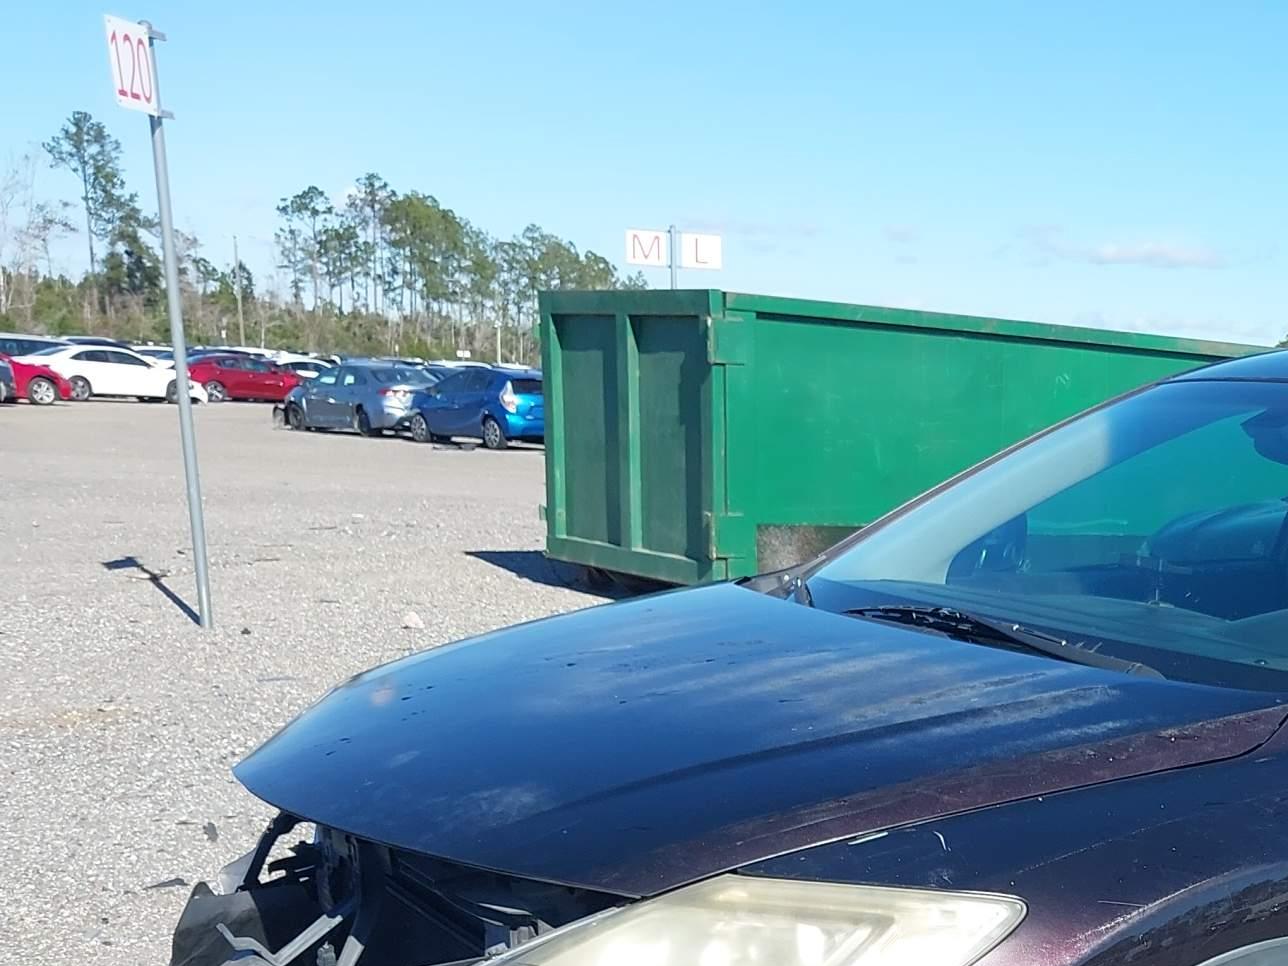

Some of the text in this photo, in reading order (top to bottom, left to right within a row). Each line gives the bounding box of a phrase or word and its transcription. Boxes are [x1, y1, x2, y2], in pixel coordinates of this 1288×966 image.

[110, 29, 153, 105] 120
[632, 233, 661, 262] M
[694, 237, 710, 265] L
